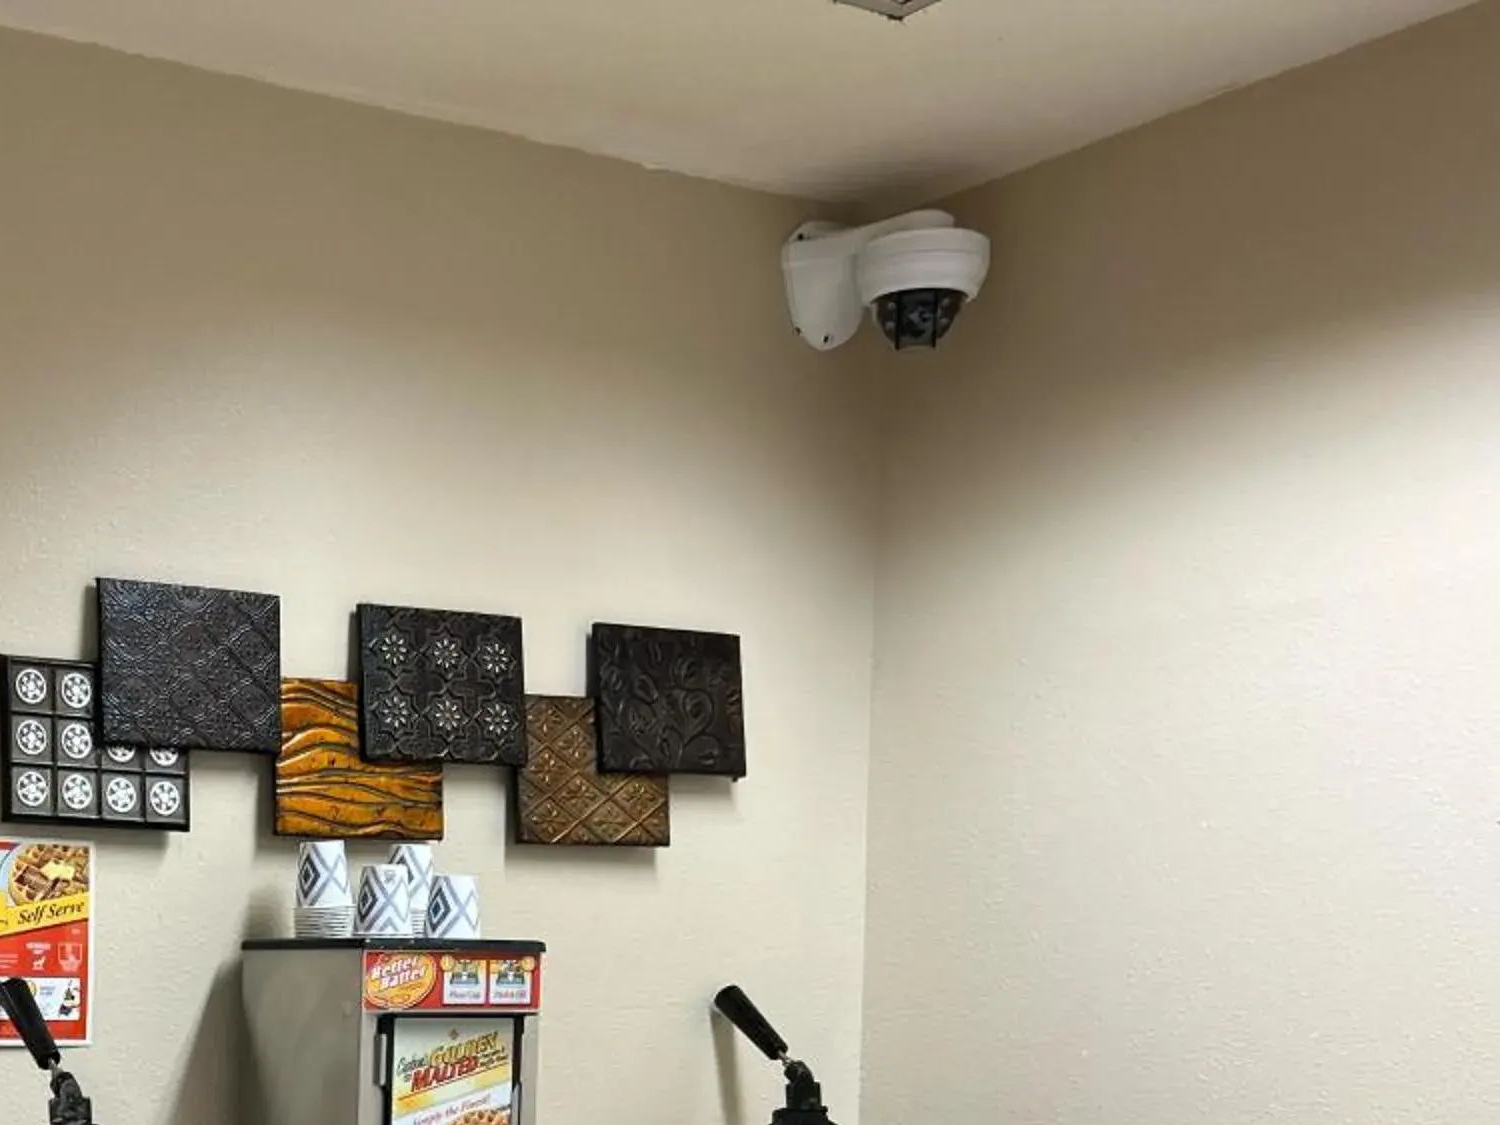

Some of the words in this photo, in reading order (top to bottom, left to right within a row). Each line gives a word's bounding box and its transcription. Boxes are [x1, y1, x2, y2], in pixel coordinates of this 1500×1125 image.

[17, 906, 44, 925] Self
[47, 901, 85, 919] Serve
[411, 1055, 479, 1092] MALTED
